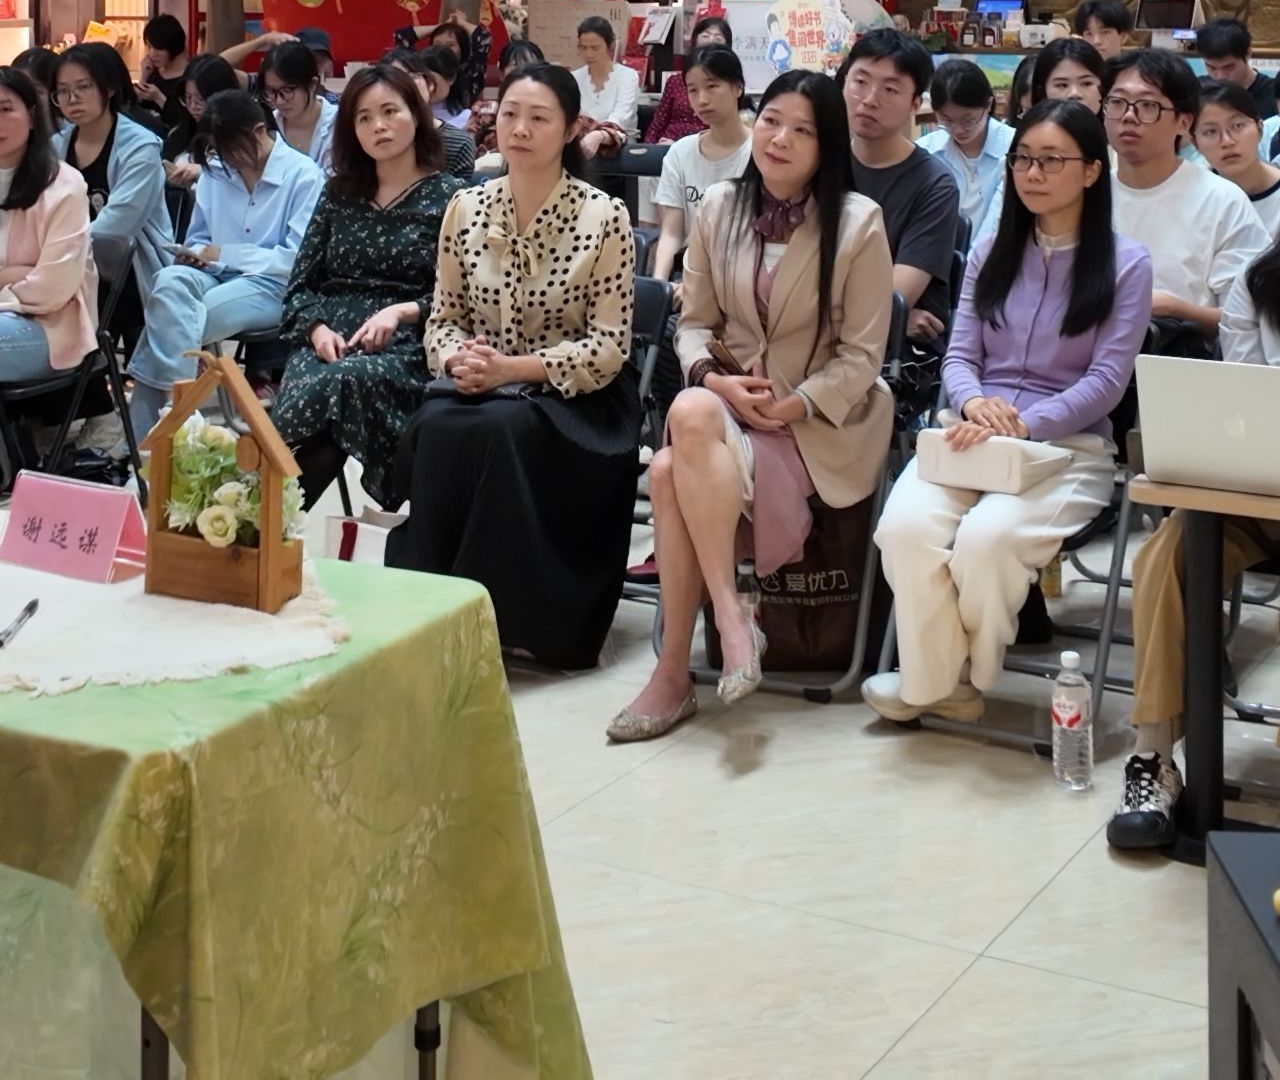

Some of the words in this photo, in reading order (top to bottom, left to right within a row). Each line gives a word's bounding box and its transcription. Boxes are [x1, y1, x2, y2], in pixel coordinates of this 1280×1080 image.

[22, 516, 99, 556] 谢远谋
[785, 569, 850, 593] 爱优力
